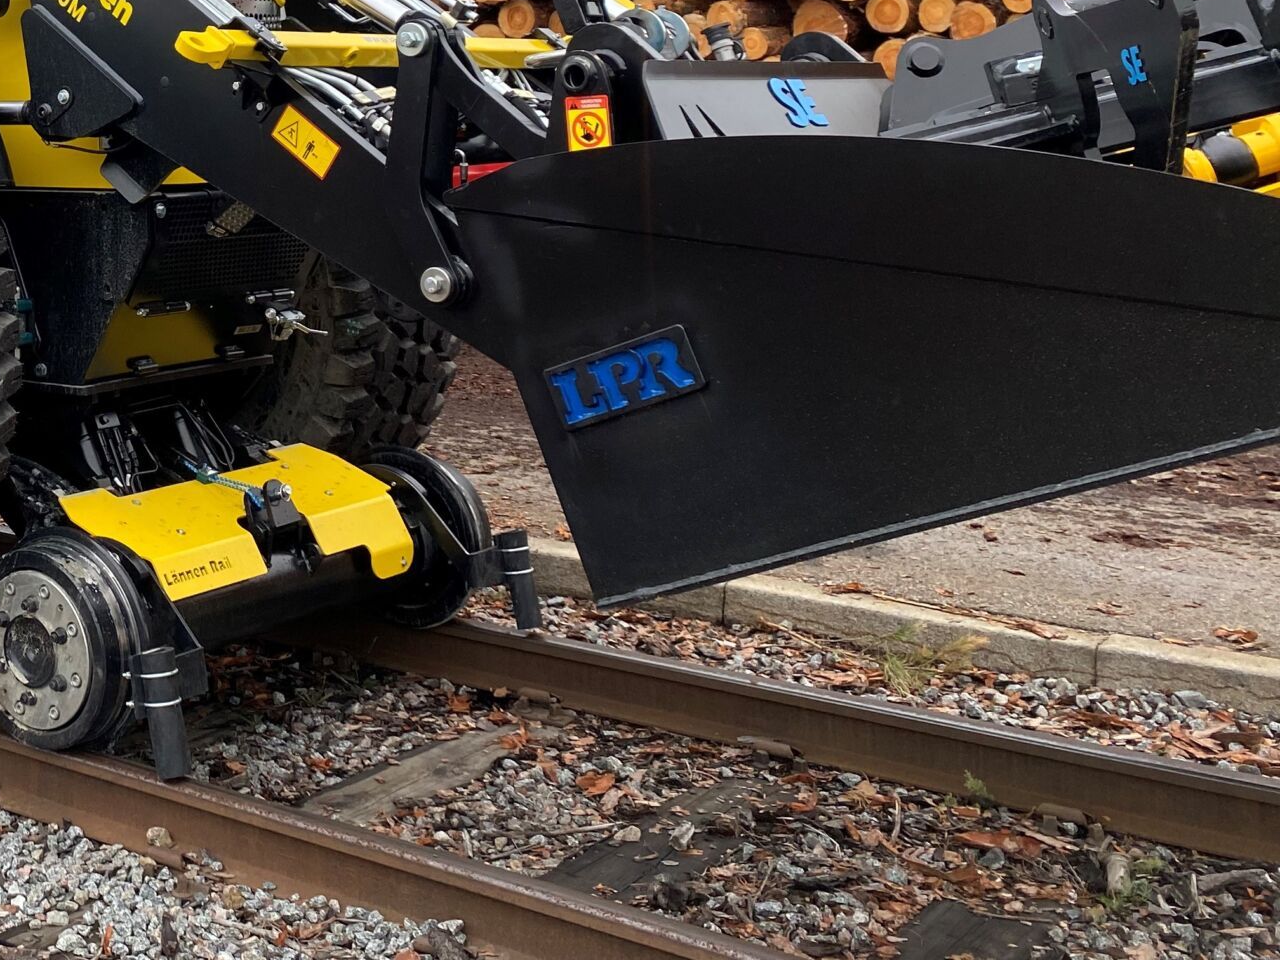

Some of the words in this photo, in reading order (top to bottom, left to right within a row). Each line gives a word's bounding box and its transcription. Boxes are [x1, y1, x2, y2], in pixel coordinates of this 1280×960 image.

[1120, 45, 1147, 86] SE
[767, 77, 830, 128] SE
[551, 338, 696, 425] LPR
[163, 565, 208, 586] Lännen
[209, 556, 232, 573] Rail
